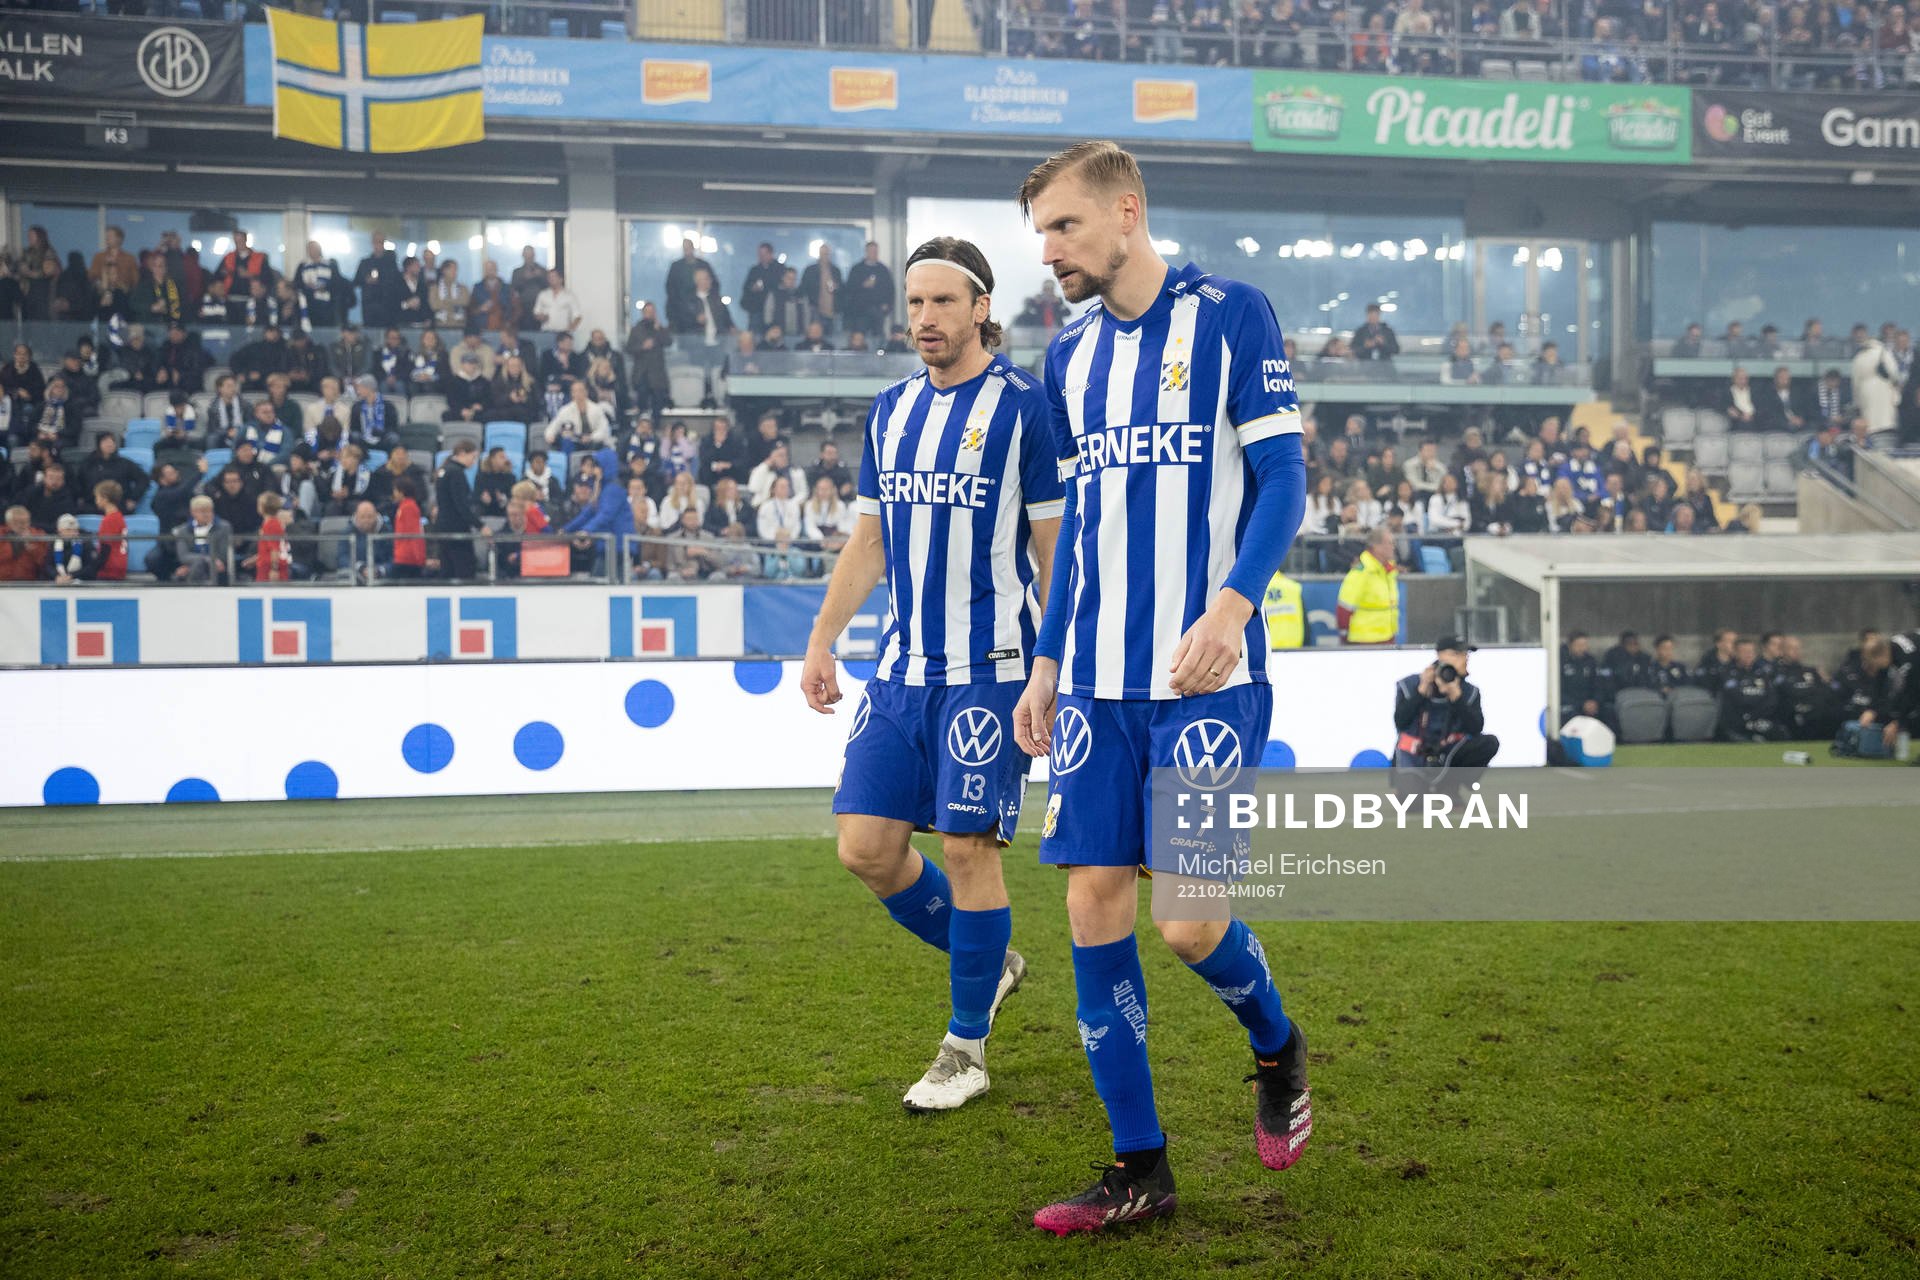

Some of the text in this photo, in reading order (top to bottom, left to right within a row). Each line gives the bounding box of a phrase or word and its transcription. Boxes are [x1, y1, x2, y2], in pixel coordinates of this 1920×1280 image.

[104, 128, 128, 144] K3
[961, 773, 986, 801] 13
[947, 802, 979, 813] CRAFT
[1169, 837, 1208, 850] CRAFT
